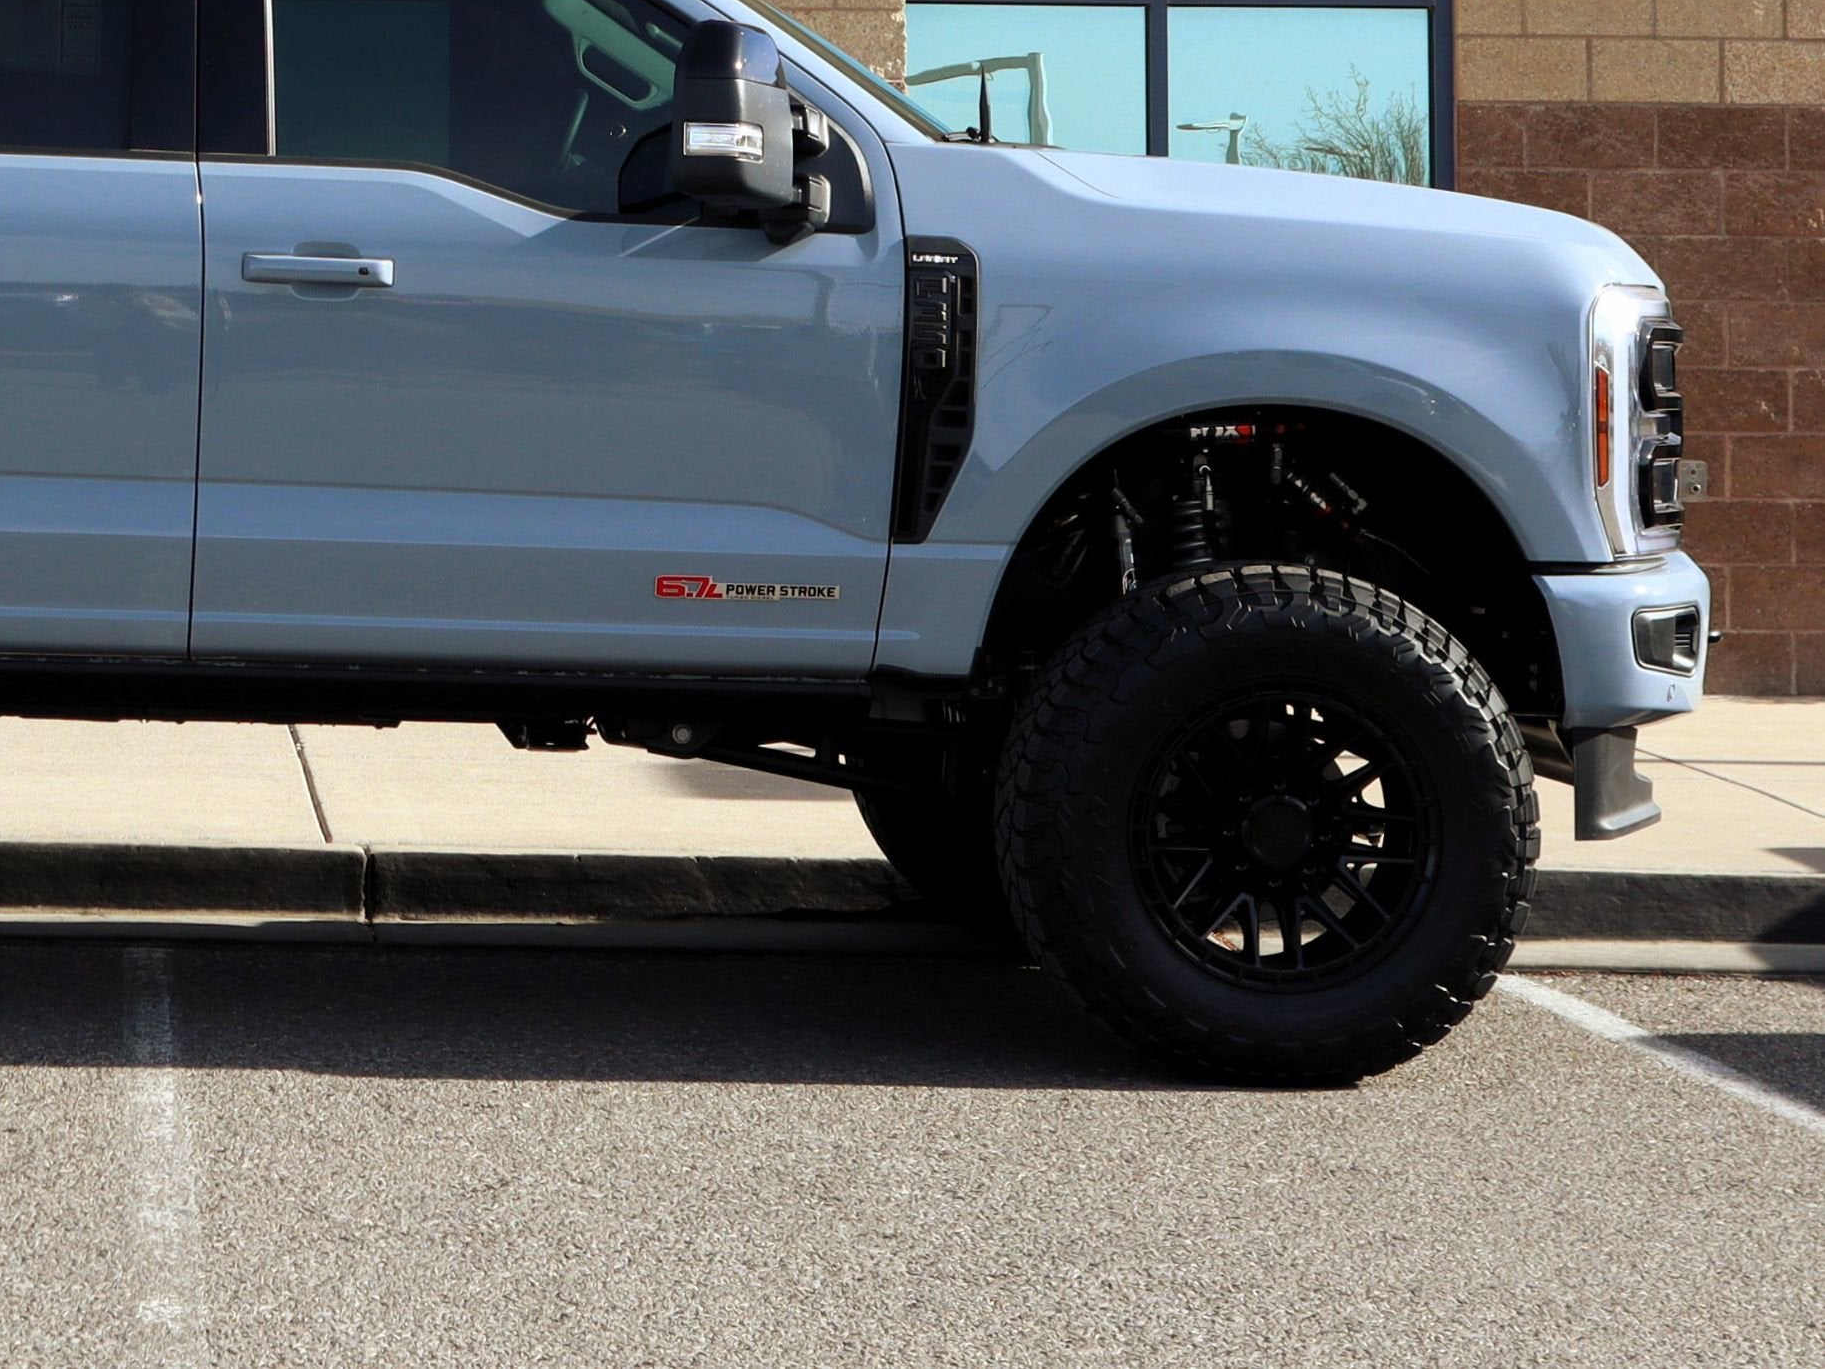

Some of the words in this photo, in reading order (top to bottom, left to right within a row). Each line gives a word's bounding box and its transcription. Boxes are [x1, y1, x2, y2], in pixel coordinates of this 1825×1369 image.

[655, 575, 723, 599] 6.7L
[725, 583, 776, 597] POWER
[779, 585, 836, 598] STROKE
